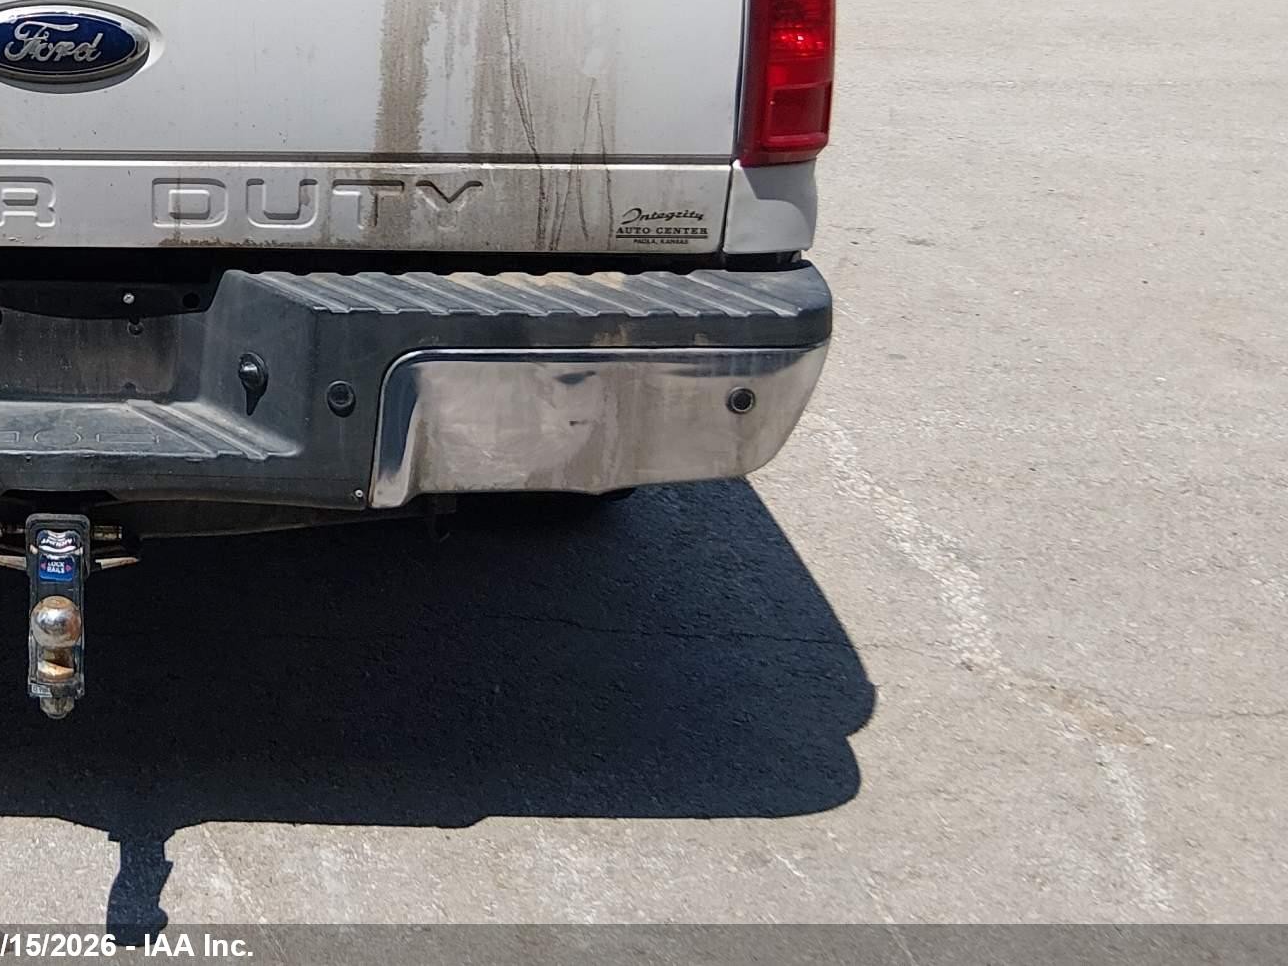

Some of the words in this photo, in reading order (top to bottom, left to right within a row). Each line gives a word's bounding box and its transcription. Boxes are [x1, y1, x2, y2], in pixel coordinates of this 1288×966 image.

[3, 20, 103, 62] Ford
[151, 177, 484, 230] DUTY
[621, 207, 704, 225] Integrity
[656, 227, 708, 235] CENTER
